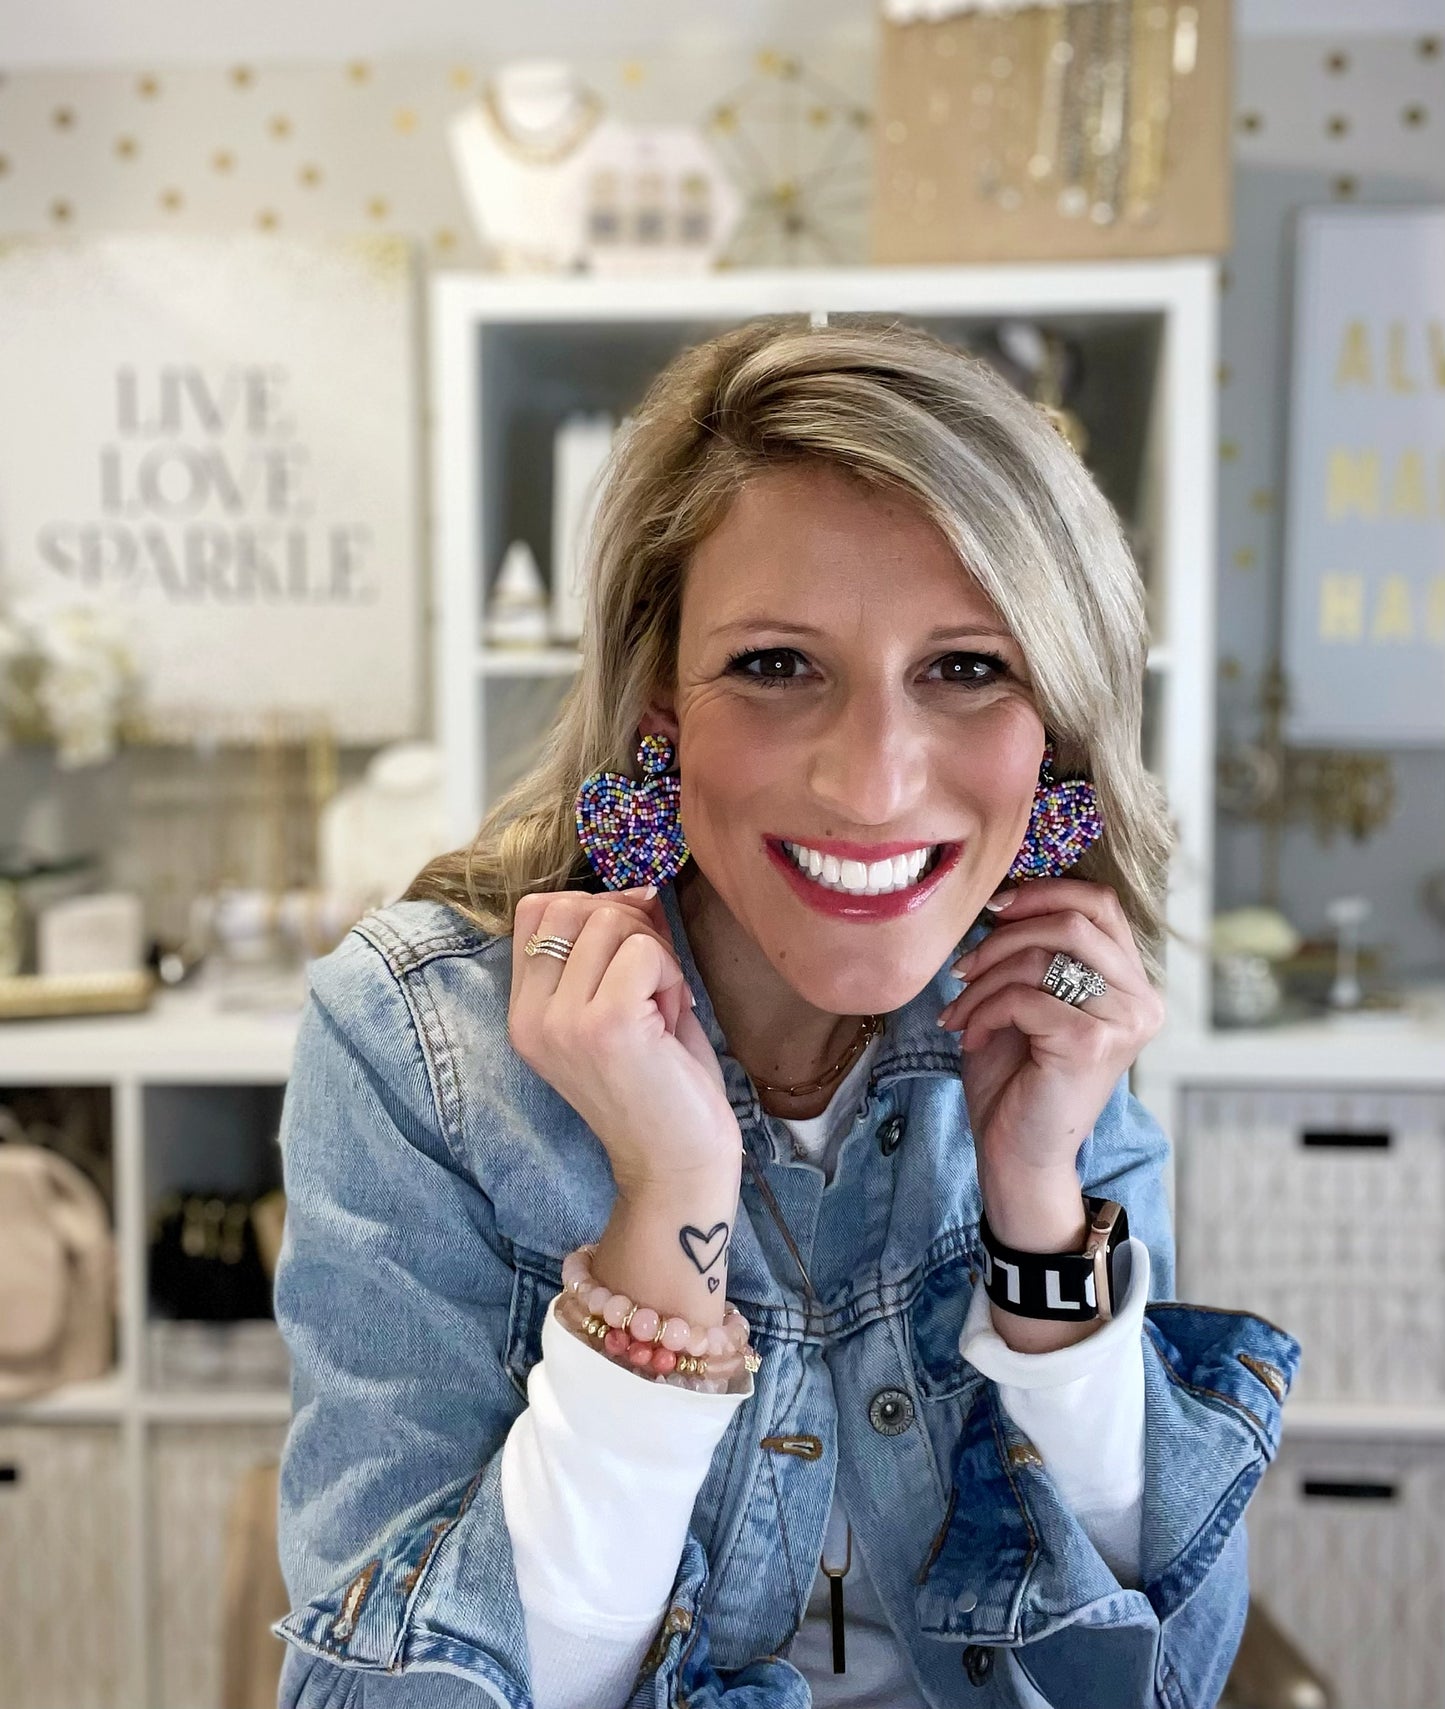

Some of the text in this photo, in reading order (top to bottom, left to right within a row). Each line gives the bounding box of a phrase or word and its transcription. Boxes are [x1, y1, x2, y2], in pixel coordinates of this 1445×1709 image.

[115, 365, 297, 438] LIVE
[102, 445, 315, 516] LOVE
[1326, 447, 1445, 521] MA
[37, 520, 378, 602] SPARKLE
